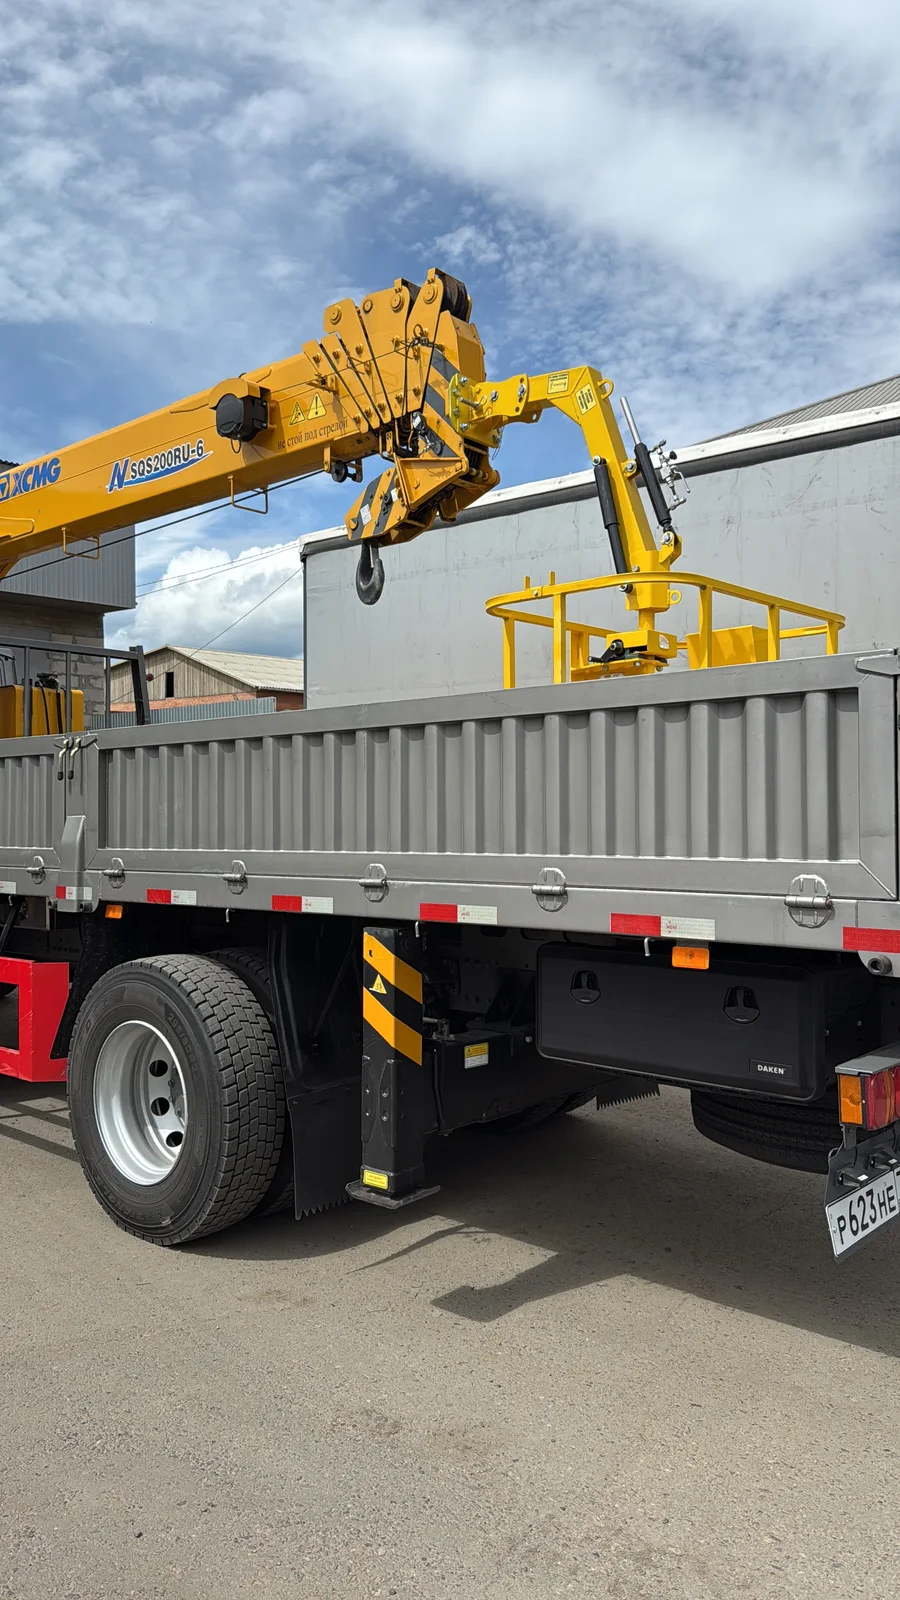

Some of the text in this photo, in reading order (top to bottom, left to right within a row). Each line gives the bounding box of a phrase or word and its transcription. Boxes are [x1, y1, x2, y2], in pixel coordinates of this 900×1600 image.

[277, 417, 348, 450] не стой под стрелой
[10, 457, 61, 498] XCMG
[130, 440, 205, 479] SQS200RU-6
[757, 1064, 784, 1075] DAKEN
